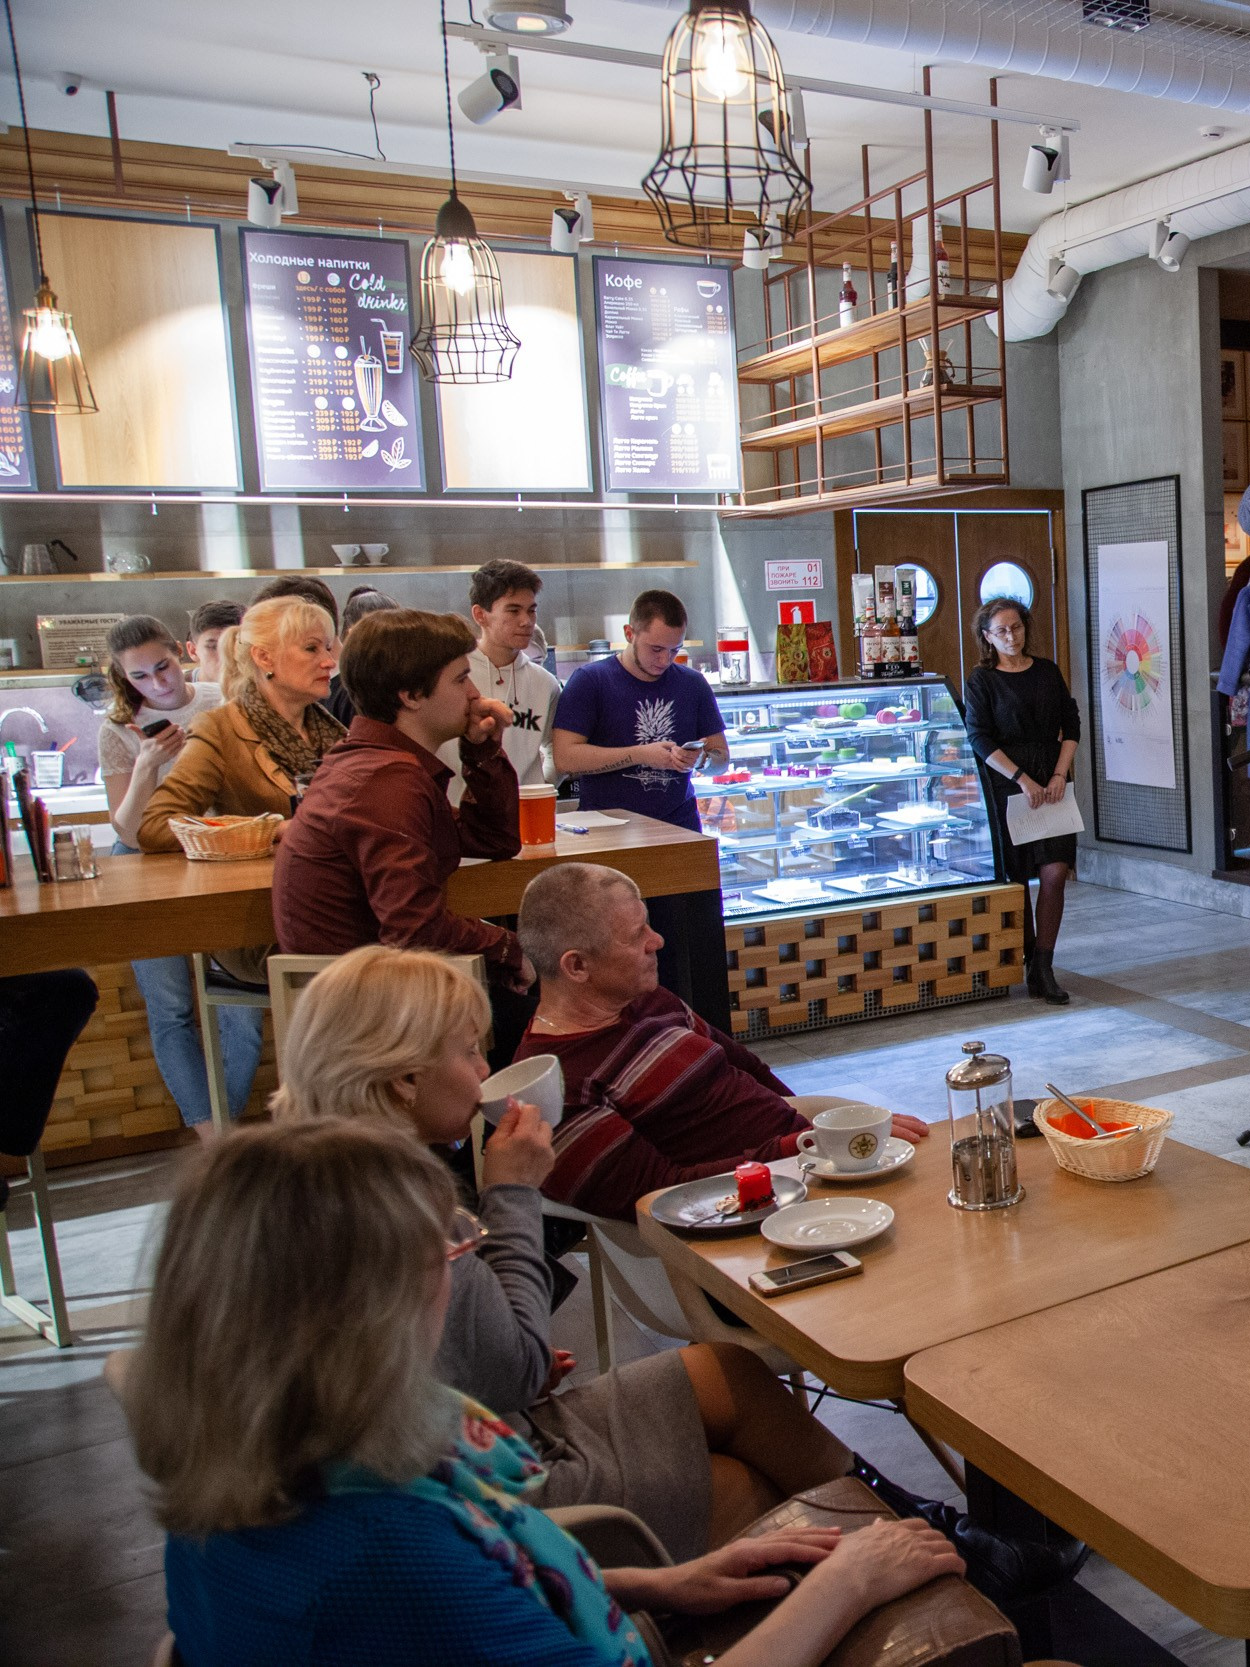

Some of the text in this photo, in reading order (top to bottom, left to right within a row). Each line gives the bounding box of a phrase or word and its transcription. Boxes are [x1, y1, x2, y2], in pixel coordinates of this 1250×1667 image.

[249, 252, 371, 271] Холодные напитки
[349, 273, 386, 292] Cold
[605, 273, 643, 291] Кофе
[357, 292, 407, 311] drinks
[610, 366, 647, 388] Coffee
[807, 563, 818, 572] 01
[803, 576, 818, 585] 112
